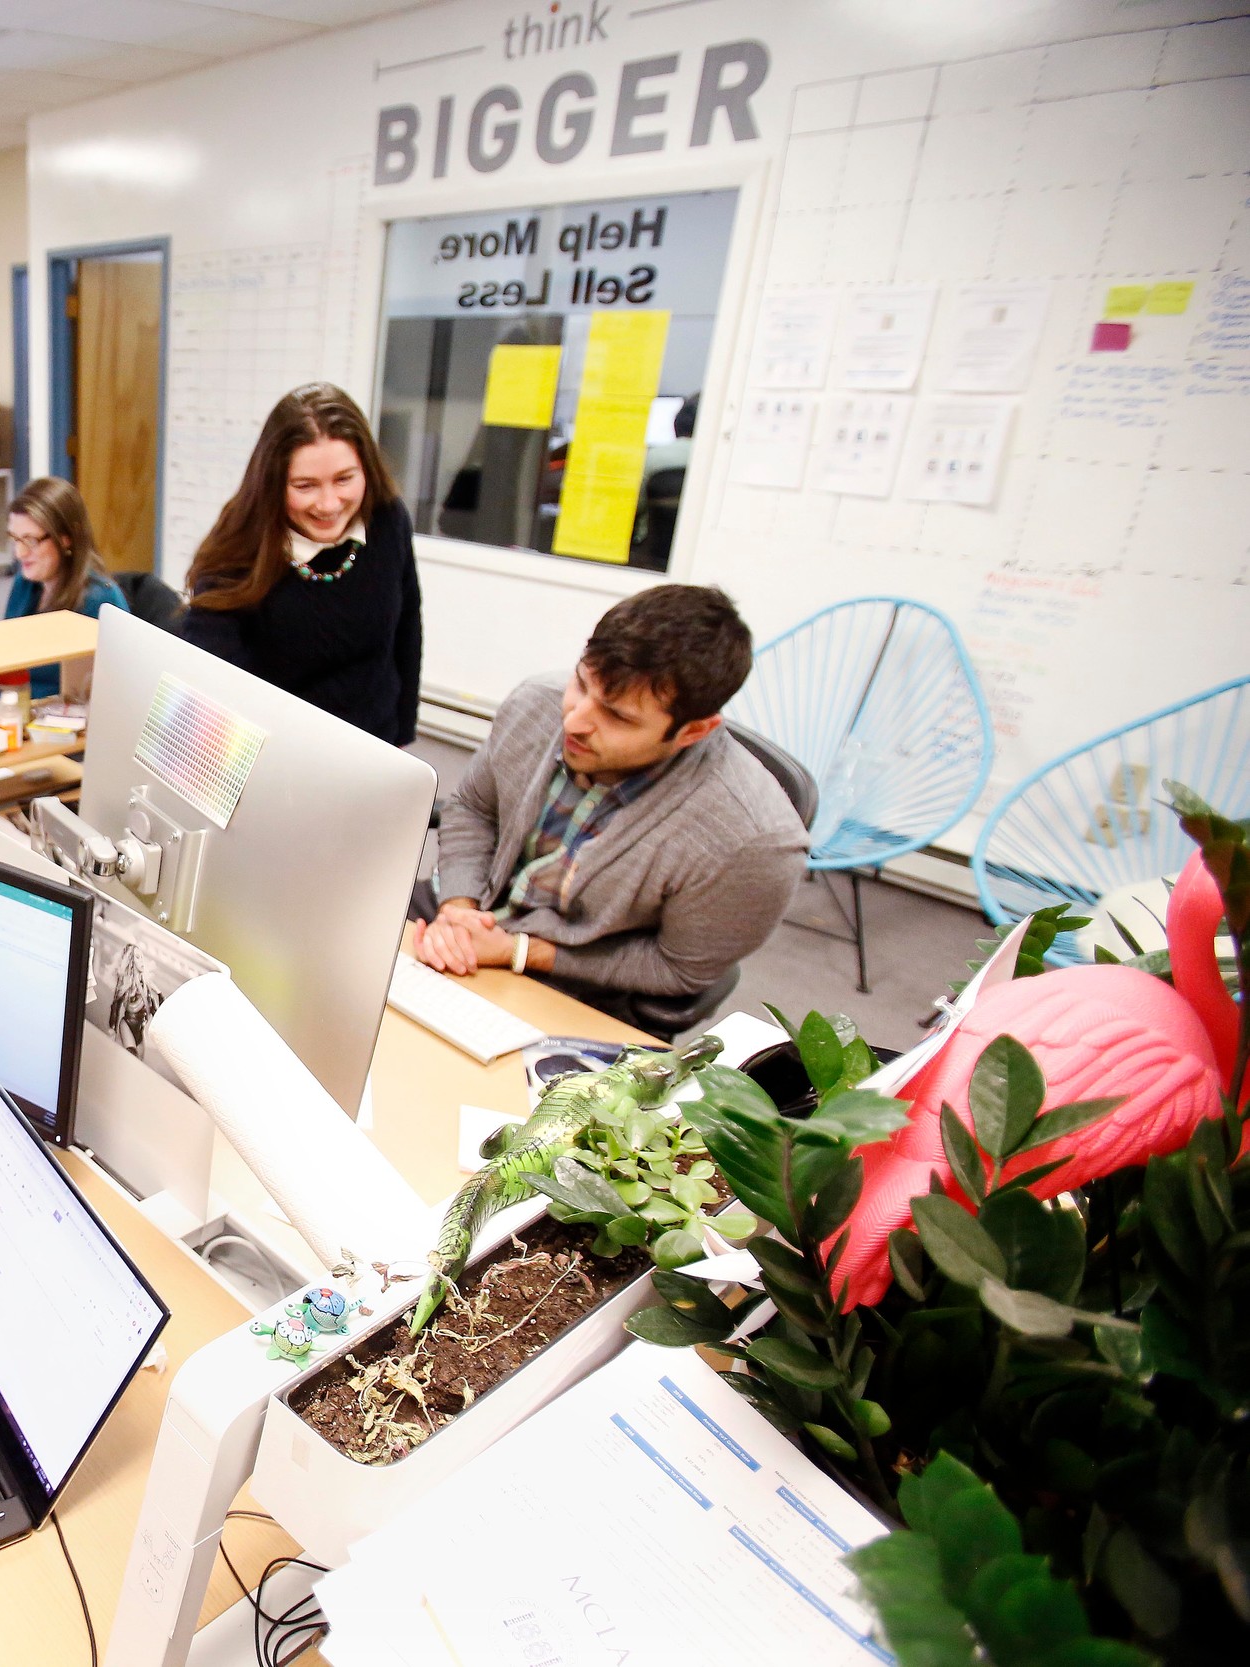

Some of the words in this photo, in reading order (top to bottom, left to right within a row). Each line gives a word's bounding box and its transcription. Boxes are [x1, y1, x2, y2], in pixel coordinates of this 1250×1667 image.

[504, 0, 611, 61] think
[374, 38, 771, 187] BIGGER
[561, 1574, 633, 1667] MCLA
